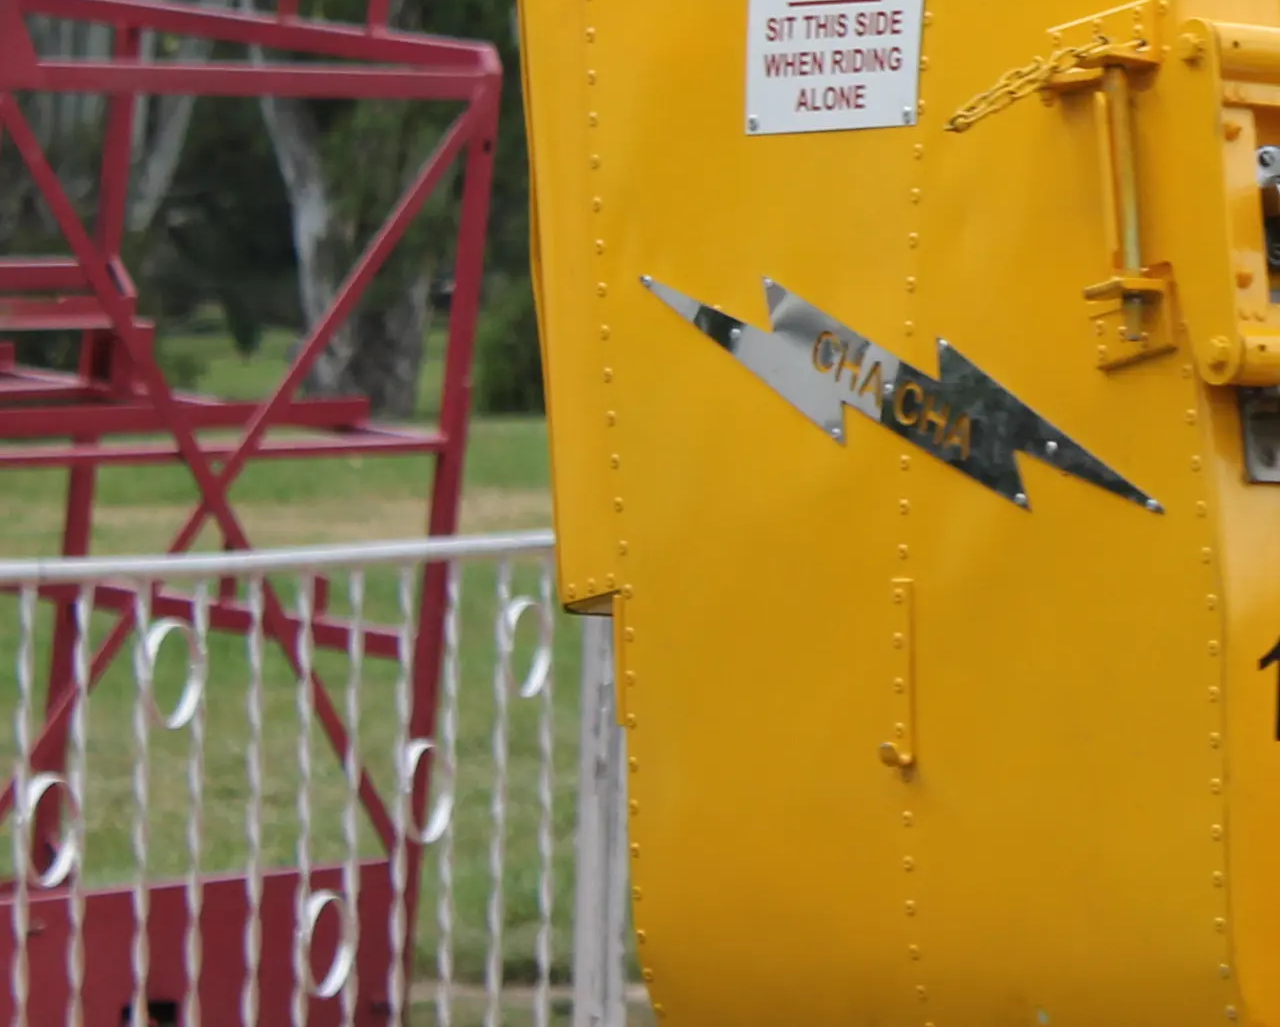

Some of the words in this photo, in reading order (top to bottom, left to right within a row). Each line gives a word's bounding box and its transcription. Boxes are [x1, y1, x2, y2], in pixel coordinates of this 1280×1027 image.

[766, 15, 797, 42] SIT
[803, 13, 848, 39] THIS
[854, 10, 903, 37] SIDE
[764, 51, 824, 78] WHEN
[831, 46, 902, 74] RIDING
[795, 84, 866, 112] ALONE
